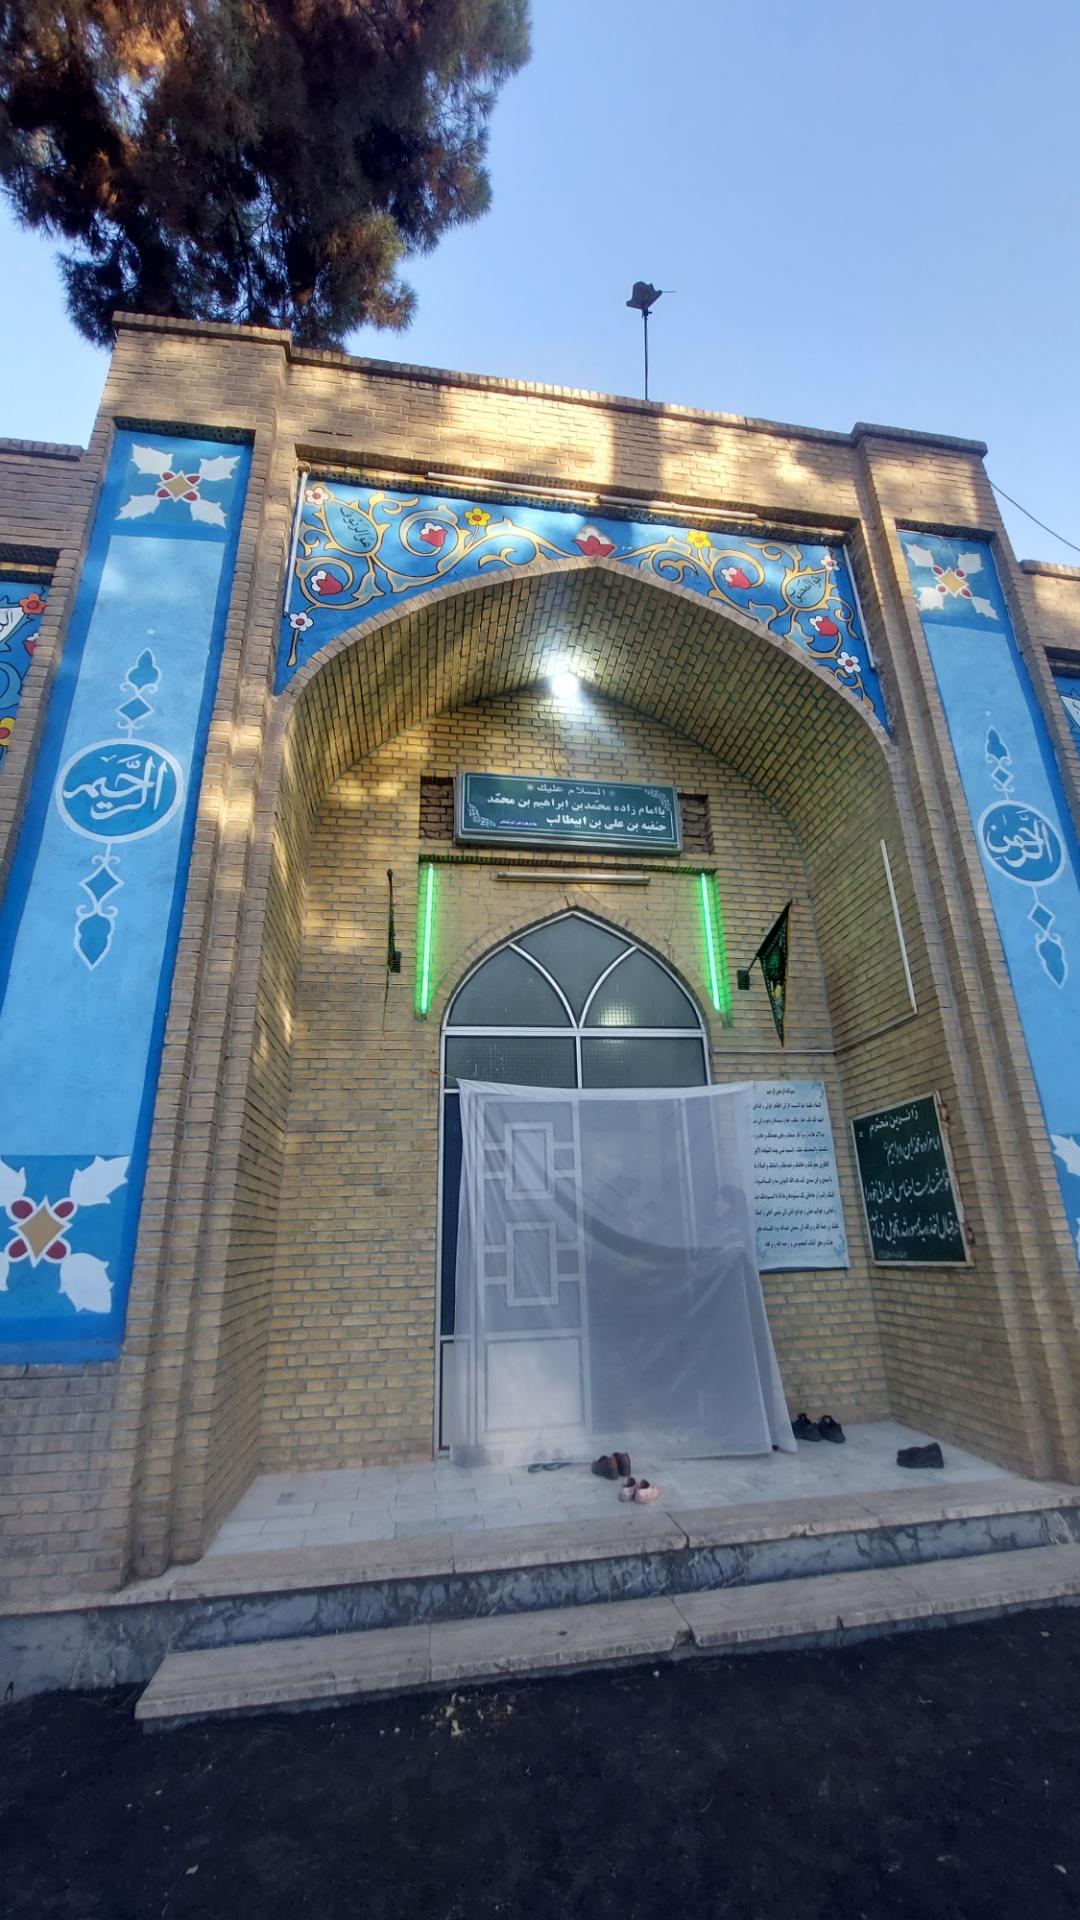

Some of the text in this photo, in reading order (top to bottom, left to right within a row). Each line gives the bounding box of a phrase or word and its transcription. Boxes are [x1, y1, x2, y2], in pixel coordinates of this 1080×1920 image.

[567, 786, 606, 796] السلام
[517, 798, 531, 808] بن
[533, 797, 569, 810] ابراهیم
[613, 804, 636, 816] زاده
[546, 814, 587, 829] ابیطالب
[589, 820, 602, 830] بن
[604, 818, 624, 830] علی
[626, 822, 639, 832] بن
[641, 820, 667, 833] حنفیه
